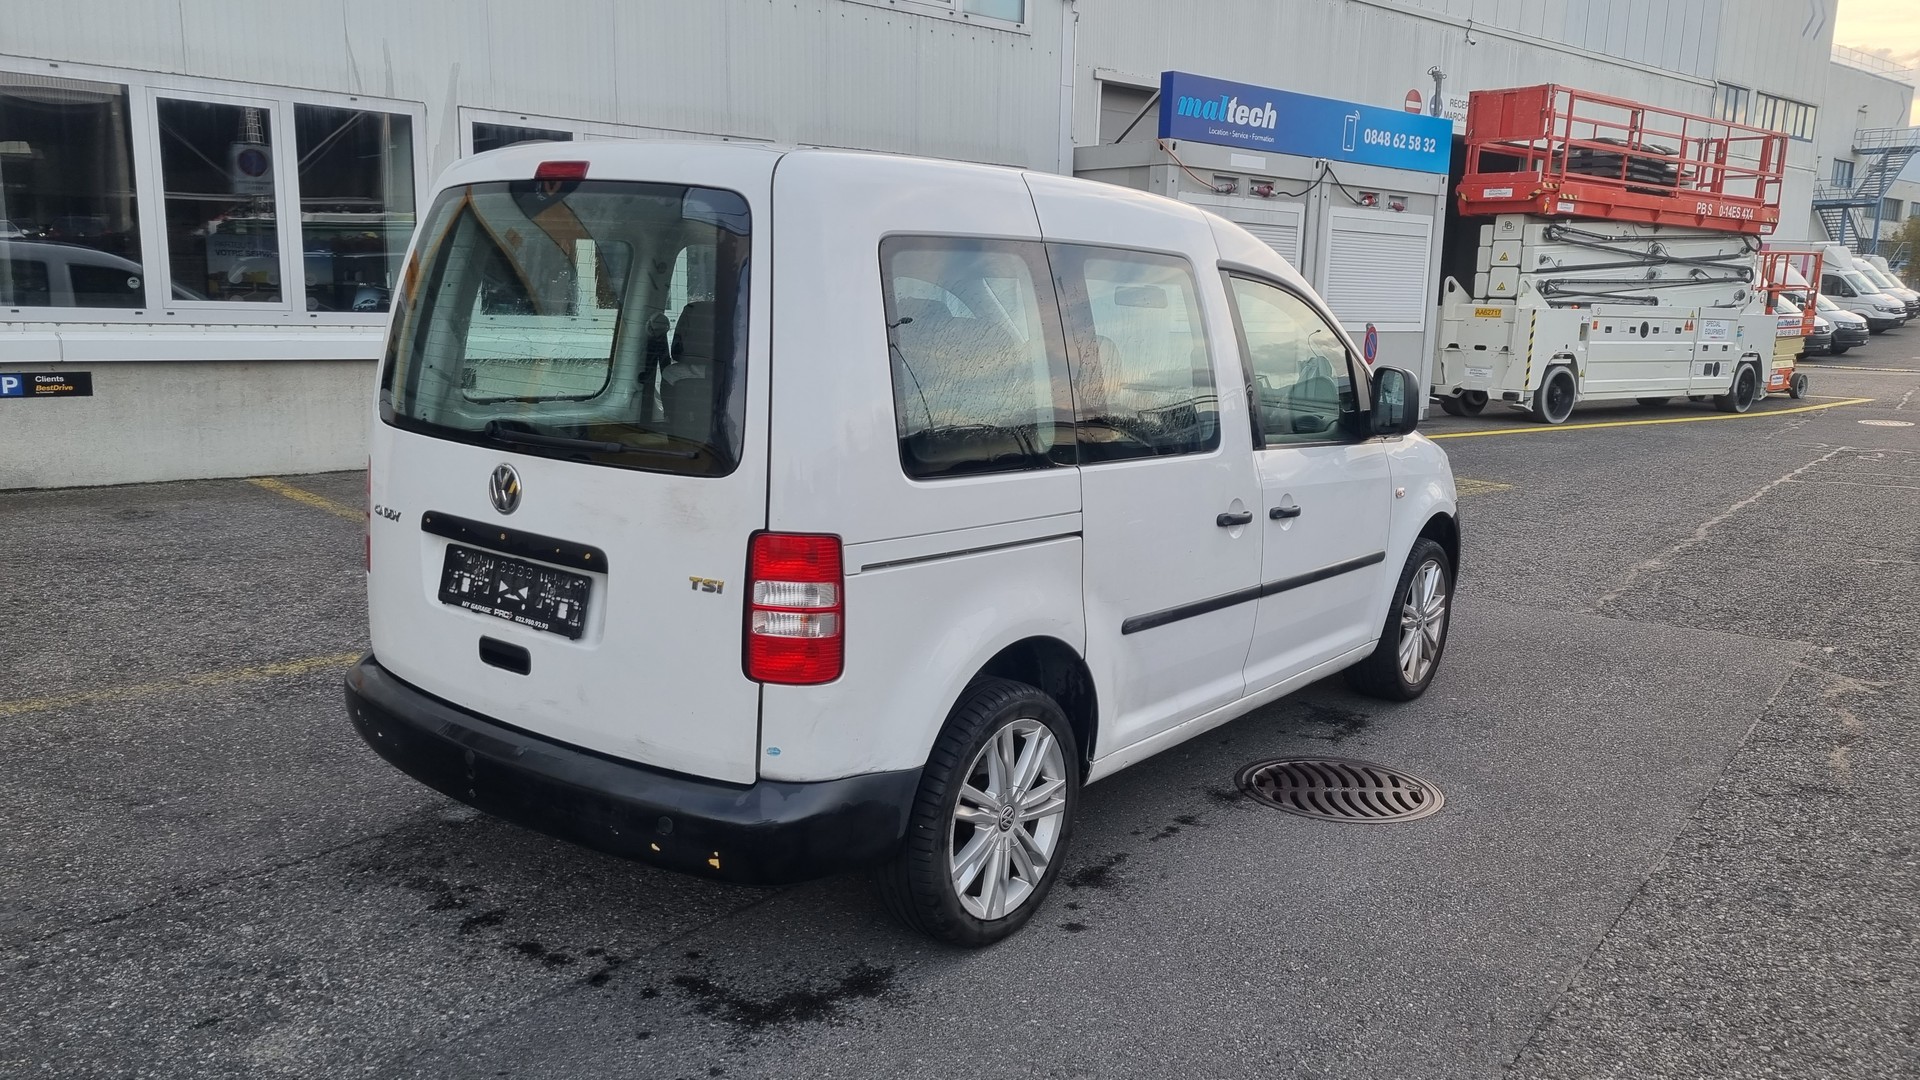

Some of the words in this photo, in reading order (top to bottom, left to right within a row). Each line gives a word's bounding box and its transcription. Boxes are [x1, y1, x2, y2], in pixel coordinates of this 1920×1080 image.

[1177, 94, 1277, 129] maltech
[1208, 126, 1229, 136] Location
[1232, 130, 1249, 139] Service
[1251, 133, 1275, 143] Formation
[1364, 128, 1391, 147] 0848
[1393, 133, 1406, 149] 62
[1408, 135, 1421, 151] 58
[1423, 138, 1436, 153] 32
[1, 376, 18, 394] P
[35, 375, 65, 383] Clients
[36, 383, 74, 391] BestDrive
[461, 600, 471, 608] MY
[470, 602, 493, 614] GARAGE
